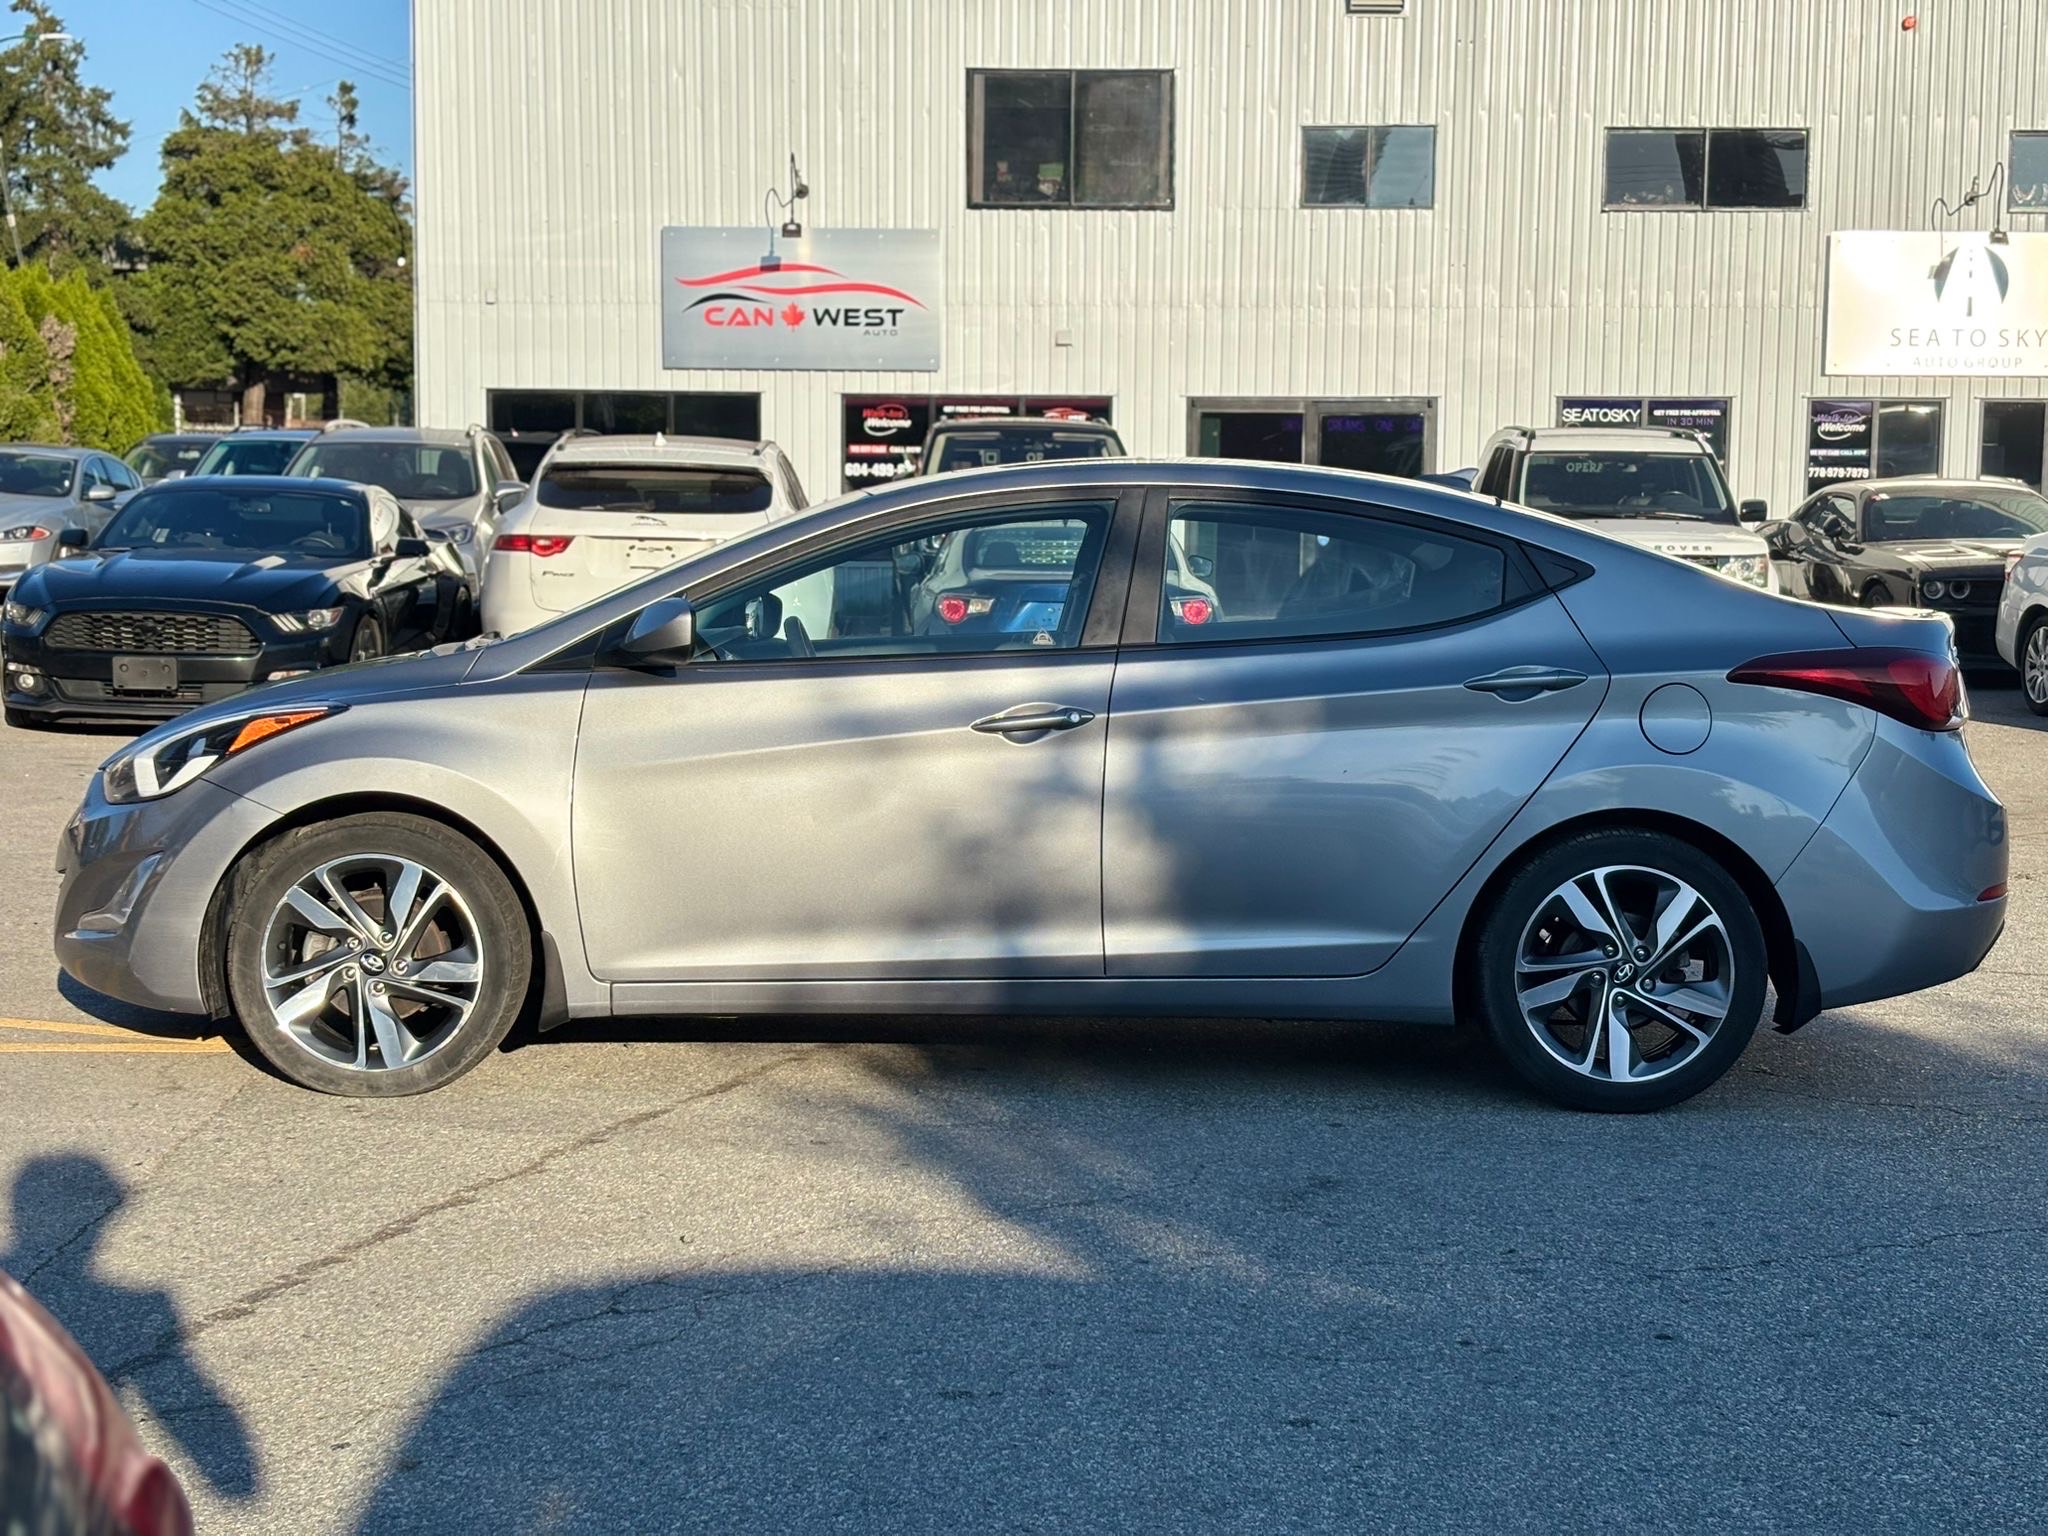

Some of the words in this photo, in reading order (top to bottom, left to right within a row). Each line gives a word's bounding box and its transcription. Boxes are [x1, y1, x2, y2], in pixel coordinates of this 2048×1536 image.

[704, 307, 773, 326] CAN
[813, 308, 904, 326] WEST
[863, 329, 898, 337] AUTO
[1890, 328, 1940, 347] SEA
[1952, 328, 1986, 348] TO
[1999, 329, 2048, 348] SKY
[1913, 357, 1958, 369] AUTO
[1964, 357, 2022, 369] GROUP
[1562, 408, 1640, 422] SEATOSKY
[867, 417, 912, 428] Welcome
[1667, 417, 1677, 425] IN
[1680, 417, 1693, 426] 30
[1696, 417, 1714, 426] MIN
[1820, 422, 1866, 432] Welcome
